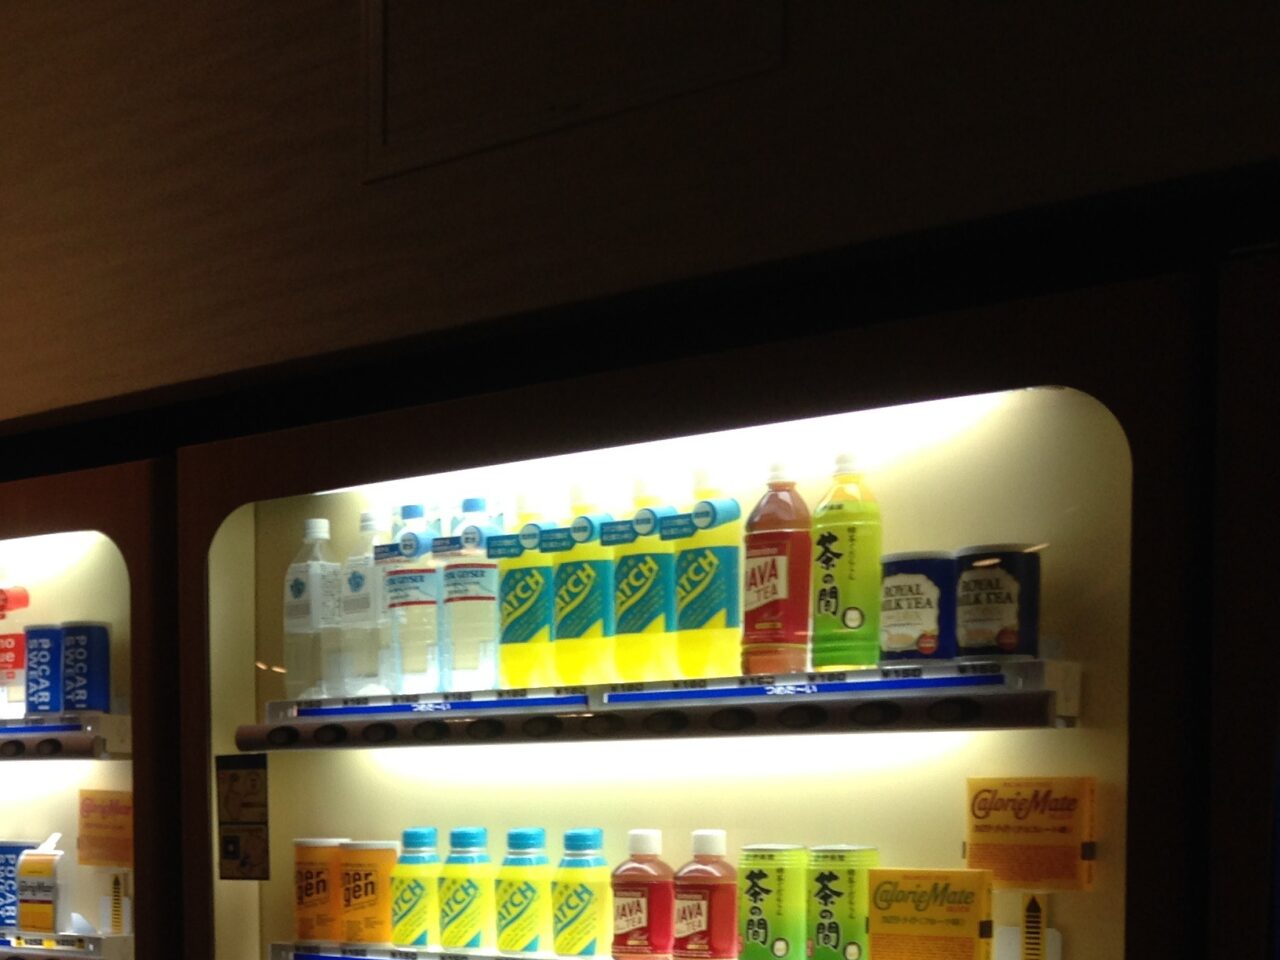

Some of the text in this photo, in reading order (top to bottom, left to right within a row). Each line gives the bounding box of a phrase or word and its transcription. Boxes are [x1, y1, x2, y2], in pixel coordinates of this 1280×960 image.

[502, 569, 544, 617] ATCH
[556, 562, 596, 610] ATCH
[616, 555, 659, 604] ATCH
[676, 549, 719, 599] ATCH
[38, 637, 50, 712] POCARI
[75, 635, 87, 711] POCARI
[5, 854, 16, 925] POCARI
[392, 879, 426, 920] ATCH
[440, 878, 479, 920] ATCH
[497, 881, 536, 923] ATCH
[554, 883, 594, 926] ATCH
[745, 869, 772, 946] 茶の間
[814, 870, 844, 950] 茶の間
[874, 881, 975, 912] CalorieMate
